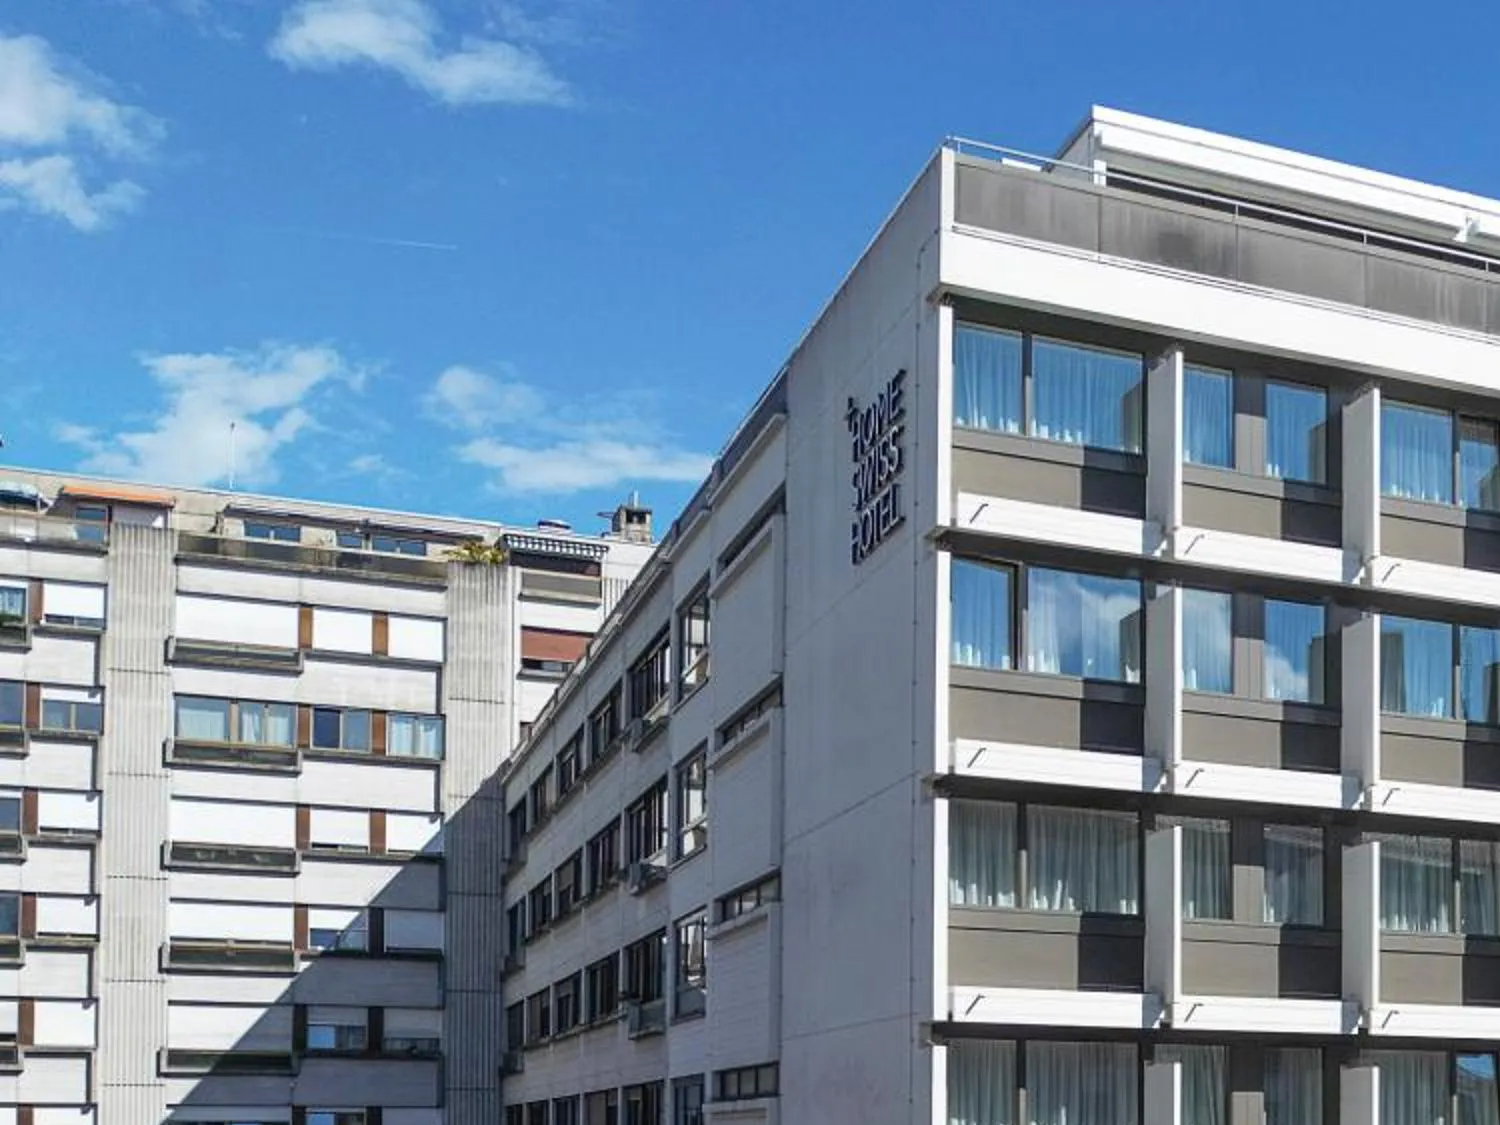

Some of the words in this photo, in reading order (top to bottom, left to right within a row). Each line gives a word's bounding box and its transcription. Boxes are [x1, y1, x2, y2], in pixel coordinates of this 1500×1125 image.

[852, 369, 907, 463] HOME
[852, 424, 905, 511] SWISS
[852, 483, 906, 565] HOTEL
